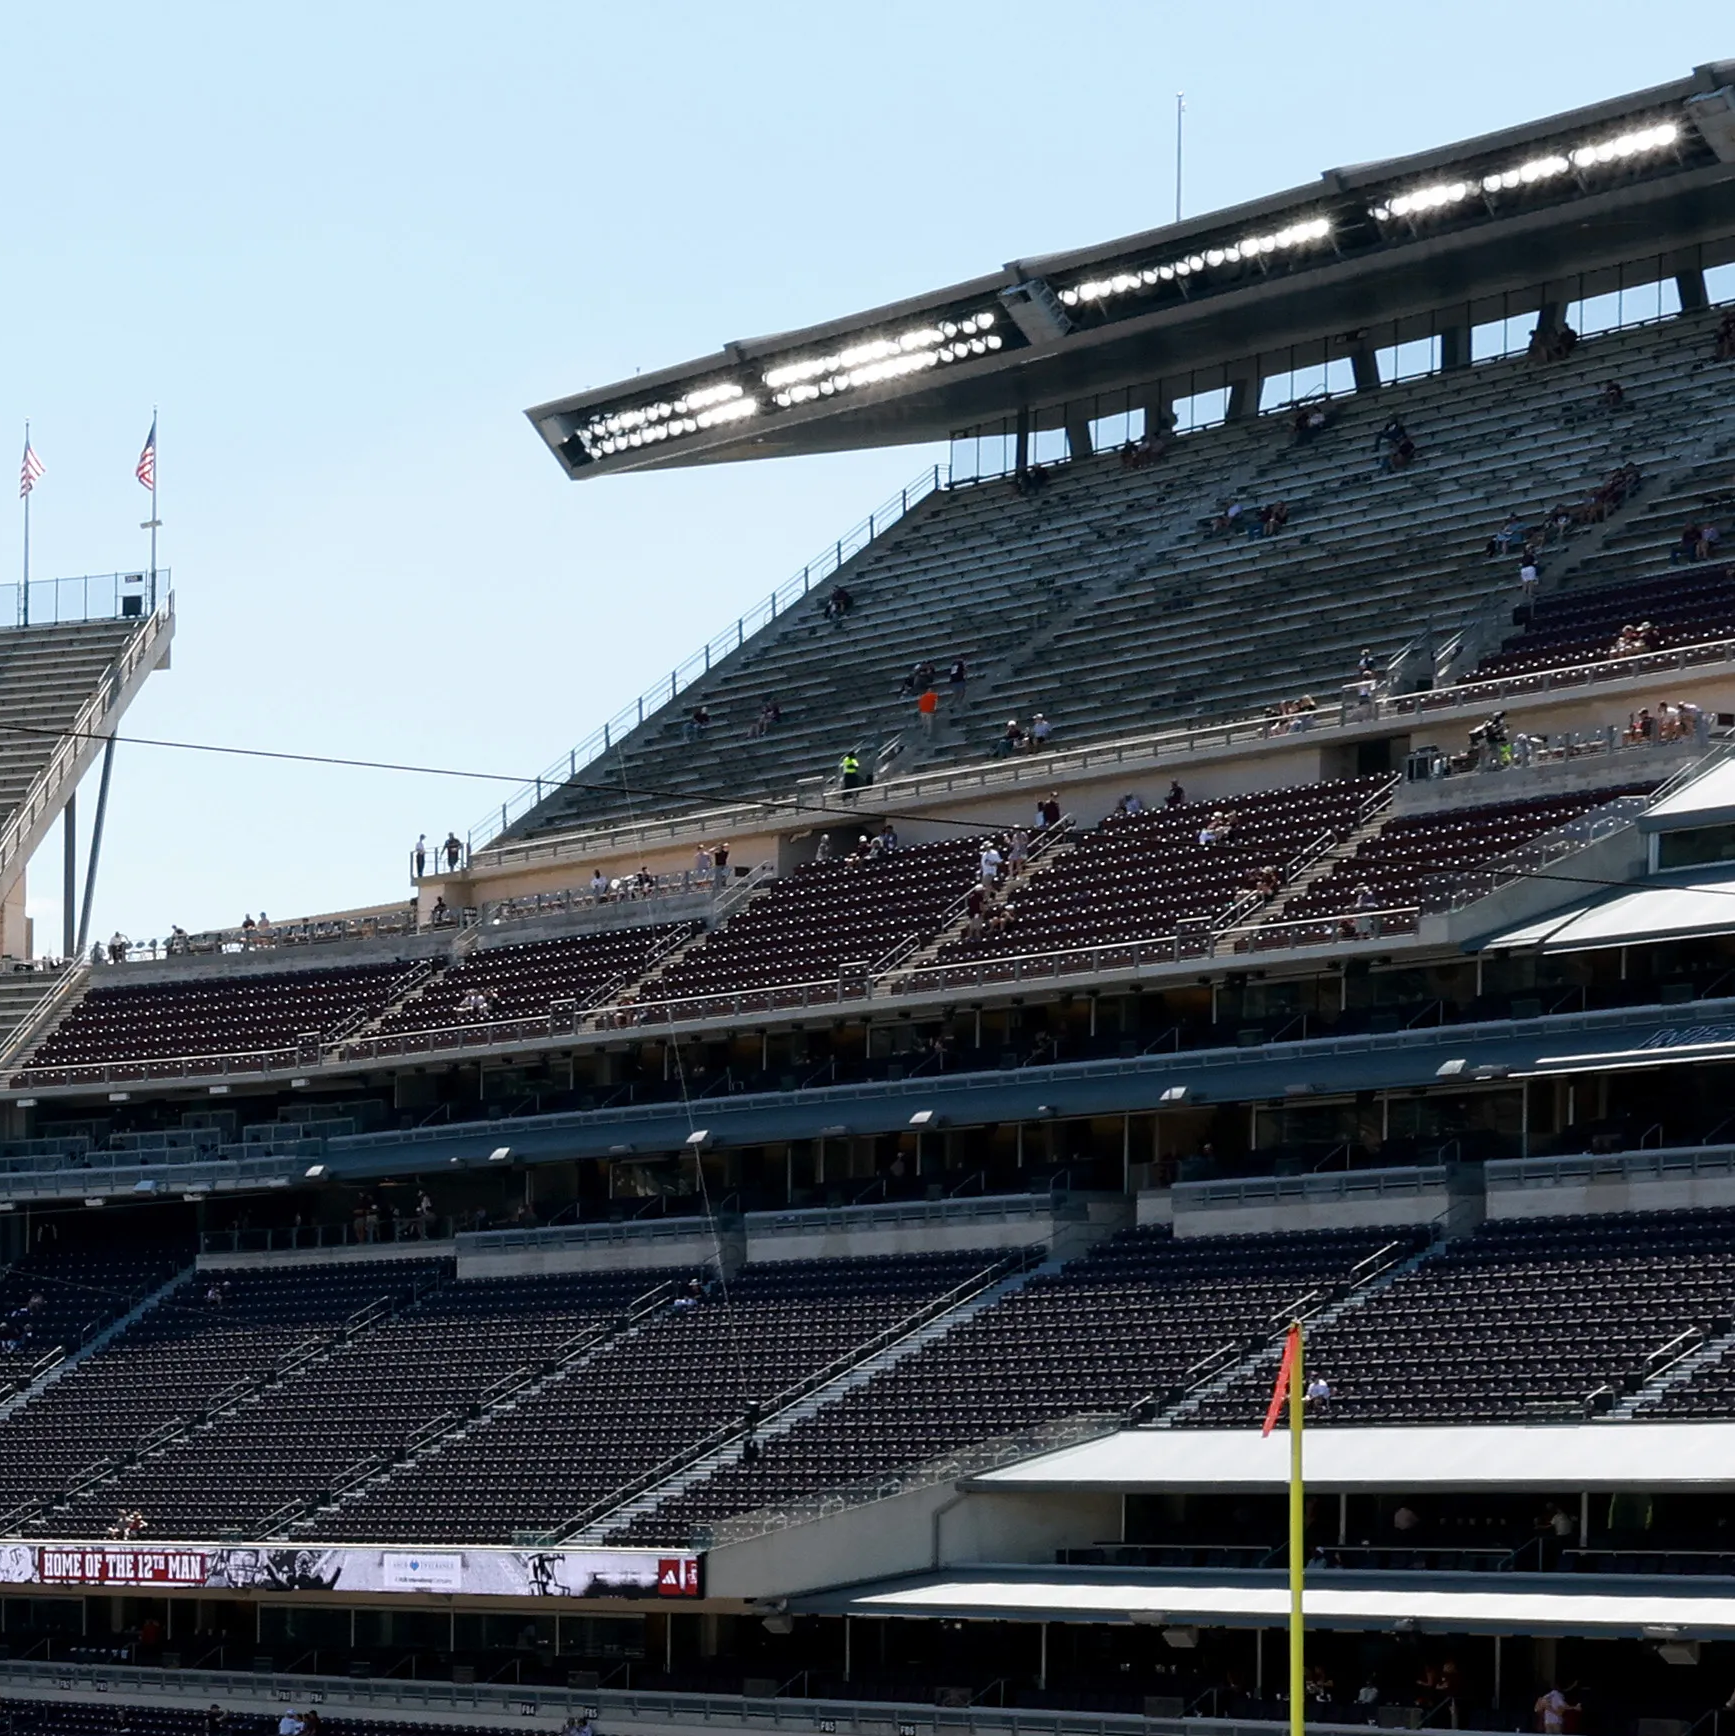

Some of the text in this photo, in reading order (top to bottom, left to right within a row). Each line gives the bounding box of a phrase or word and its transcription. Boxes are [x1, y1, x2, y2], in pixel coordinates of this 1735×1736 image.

[43, 1552, 81, 1579] HOME
[85, 1552, 102, 1579] OF
[106, 1552, 133, 1580] THE
[137, 1553, 165, 1580] 12TH
